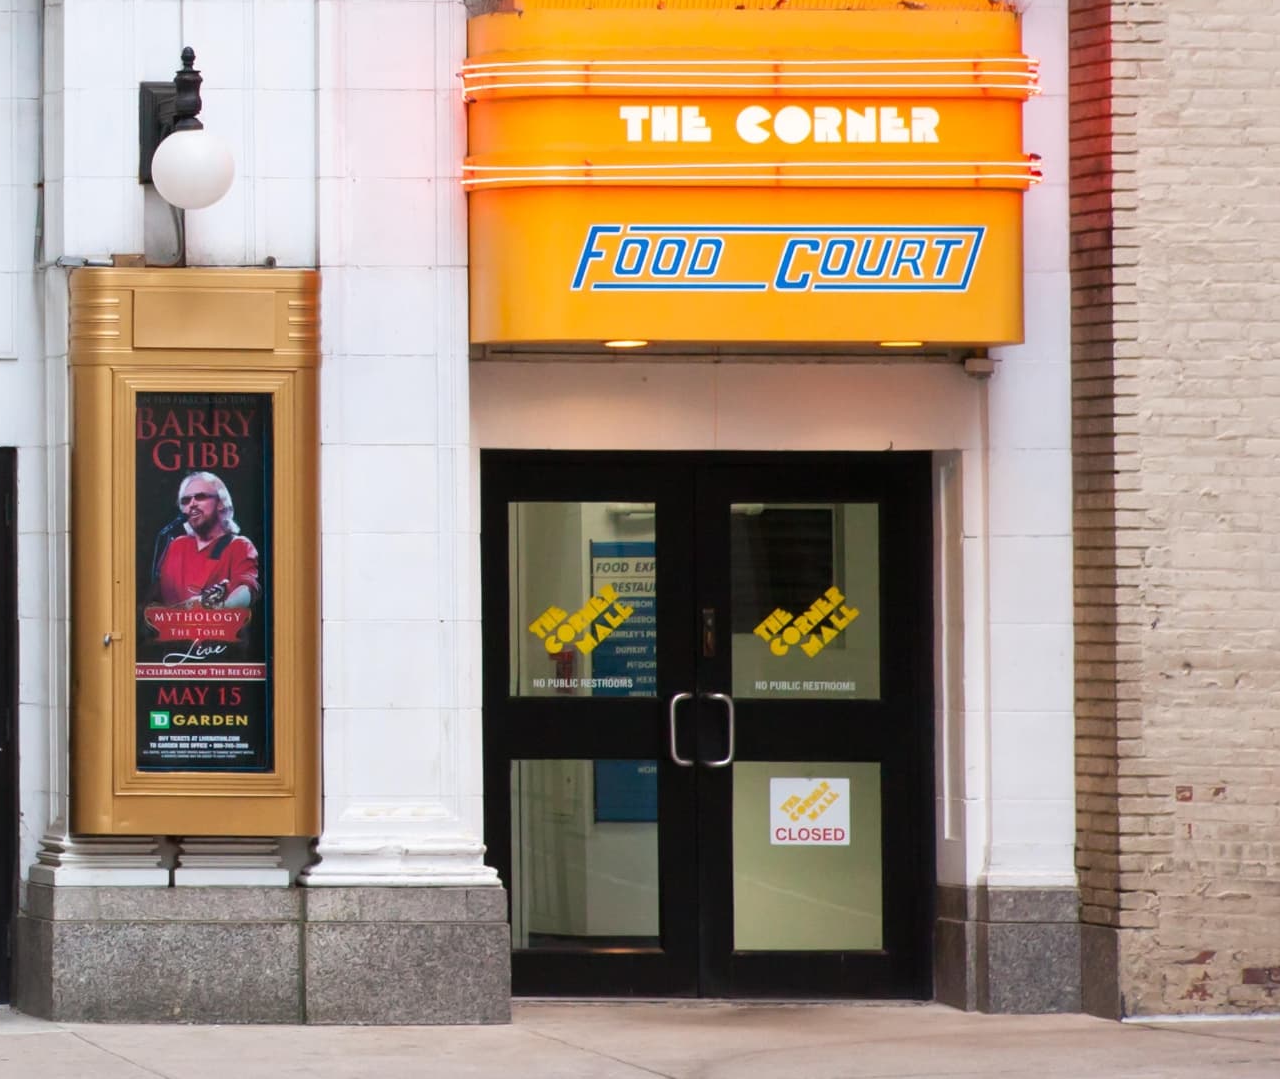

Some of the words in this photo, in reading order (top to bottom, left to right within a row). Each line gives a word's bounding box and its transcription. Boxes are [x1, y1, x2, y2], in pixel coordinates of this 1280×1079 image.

[620, 106, 712, 142] THE
[736, 105, 940, 144] CORNER
[571, 224, 725, 291] FOOD
[774, 236, 964, 291] COURT
[136, 407, 256, 440] BARRY
[151, 438, 240, 471] GIBB
[595, 562, 629, 573] FOOD
[611, 581, 656, 593] RESTAU
[154, 612, 242, 622] MYTHOLOGY
[528, 605, 568, 639] THE
[575, 603, 634, 655] MALL
[753, 607, 793, 642] THE
[770, 585, 846, 656] CORNER
[801, 605, 860, 658] MALL
[170, 628, 190, 636] THE
[196, 628, 226, 636] TOUR
[162, 638, 227, 667] Live
[157, 686, 209, 705] MAY
[218, 686, 242, 706] 15
[533, 678, 546, 688] NO
[547, 678, 578, 688] PUBLIC
[581, 678, 634, 688] RESTROOMS
[754, 680, 768, 691] NO
[769, 680, 801, 691] PUBLIC
[802, 680, 856, 691] RESTROOMS
[152, 713, 169, 726] TD
[172, 714, 249, 726] GARDEN
[775, 827, 846, 841] CLOSED
